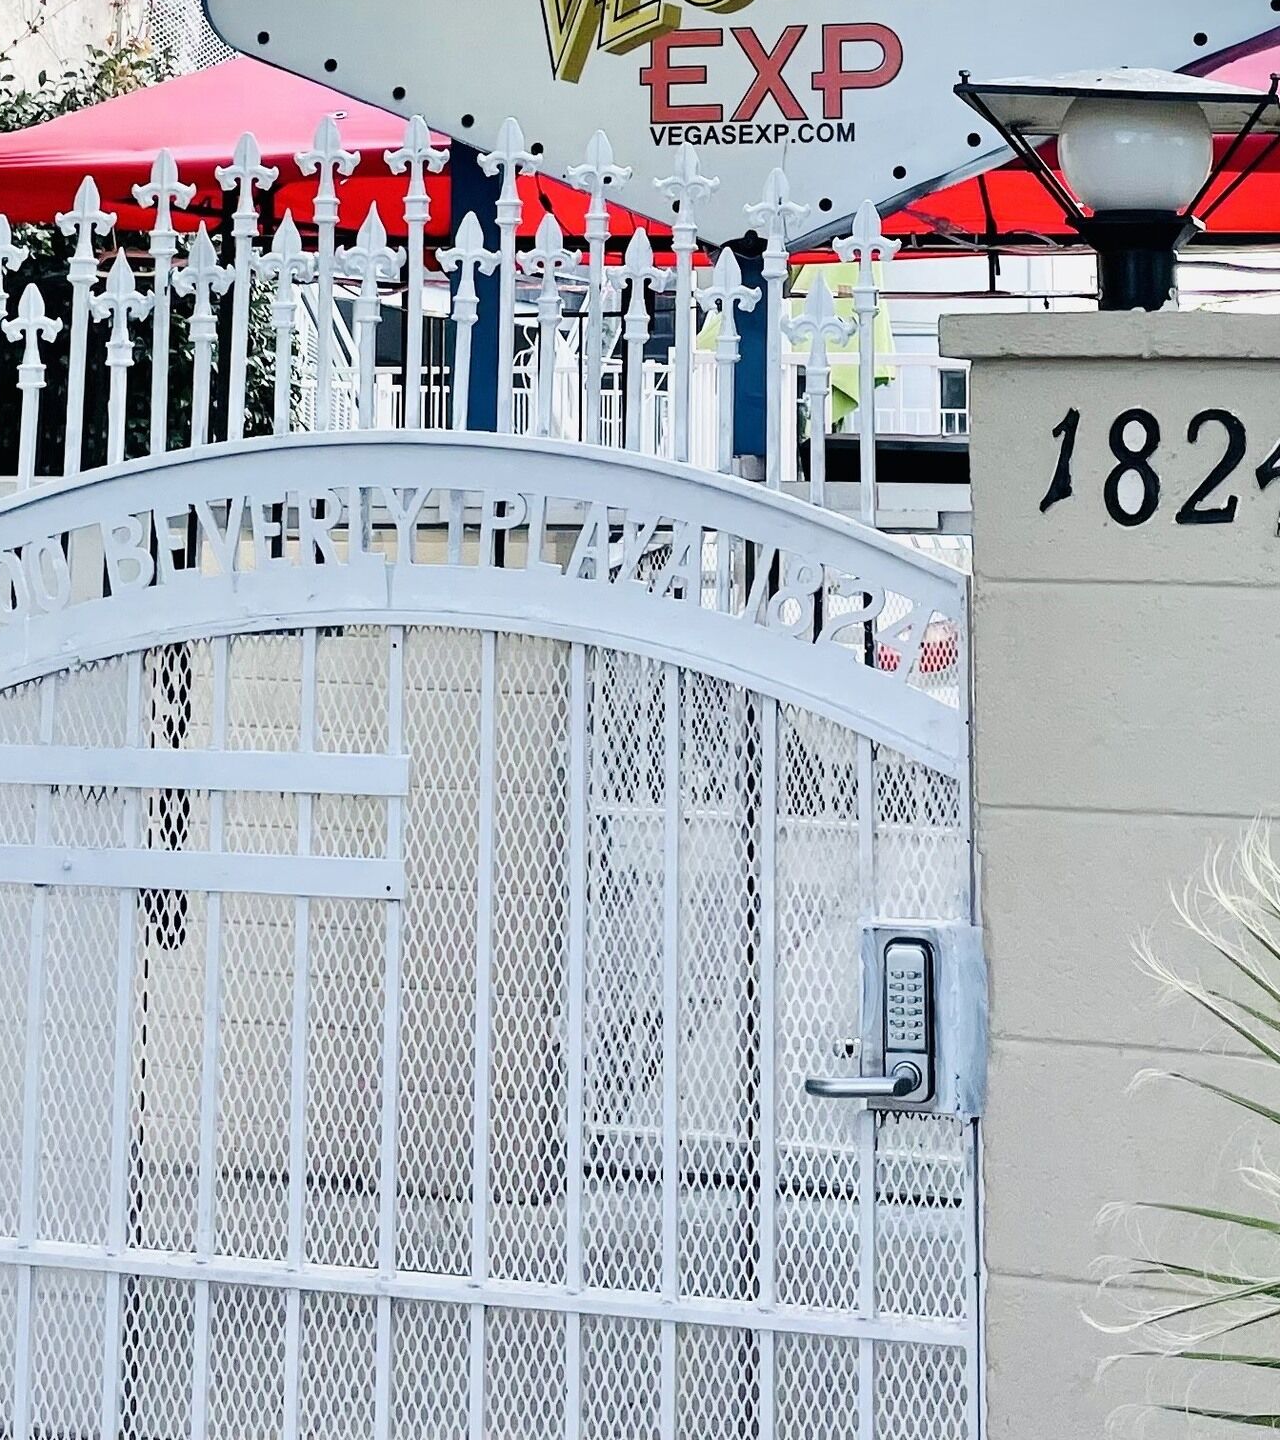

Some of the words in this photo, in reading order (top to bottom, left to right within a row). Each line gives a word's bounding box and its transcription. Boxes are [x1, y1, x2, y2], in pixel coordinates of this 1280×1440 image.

[639, 22, 904, 124] EXP
[649, 122, 856, 147] VEGASEXP.COM
[100, 486, 433, 594] BEVERLY
[478, 491, 704, 606] PLAZA
[742, 542, 936, 684] 1824
